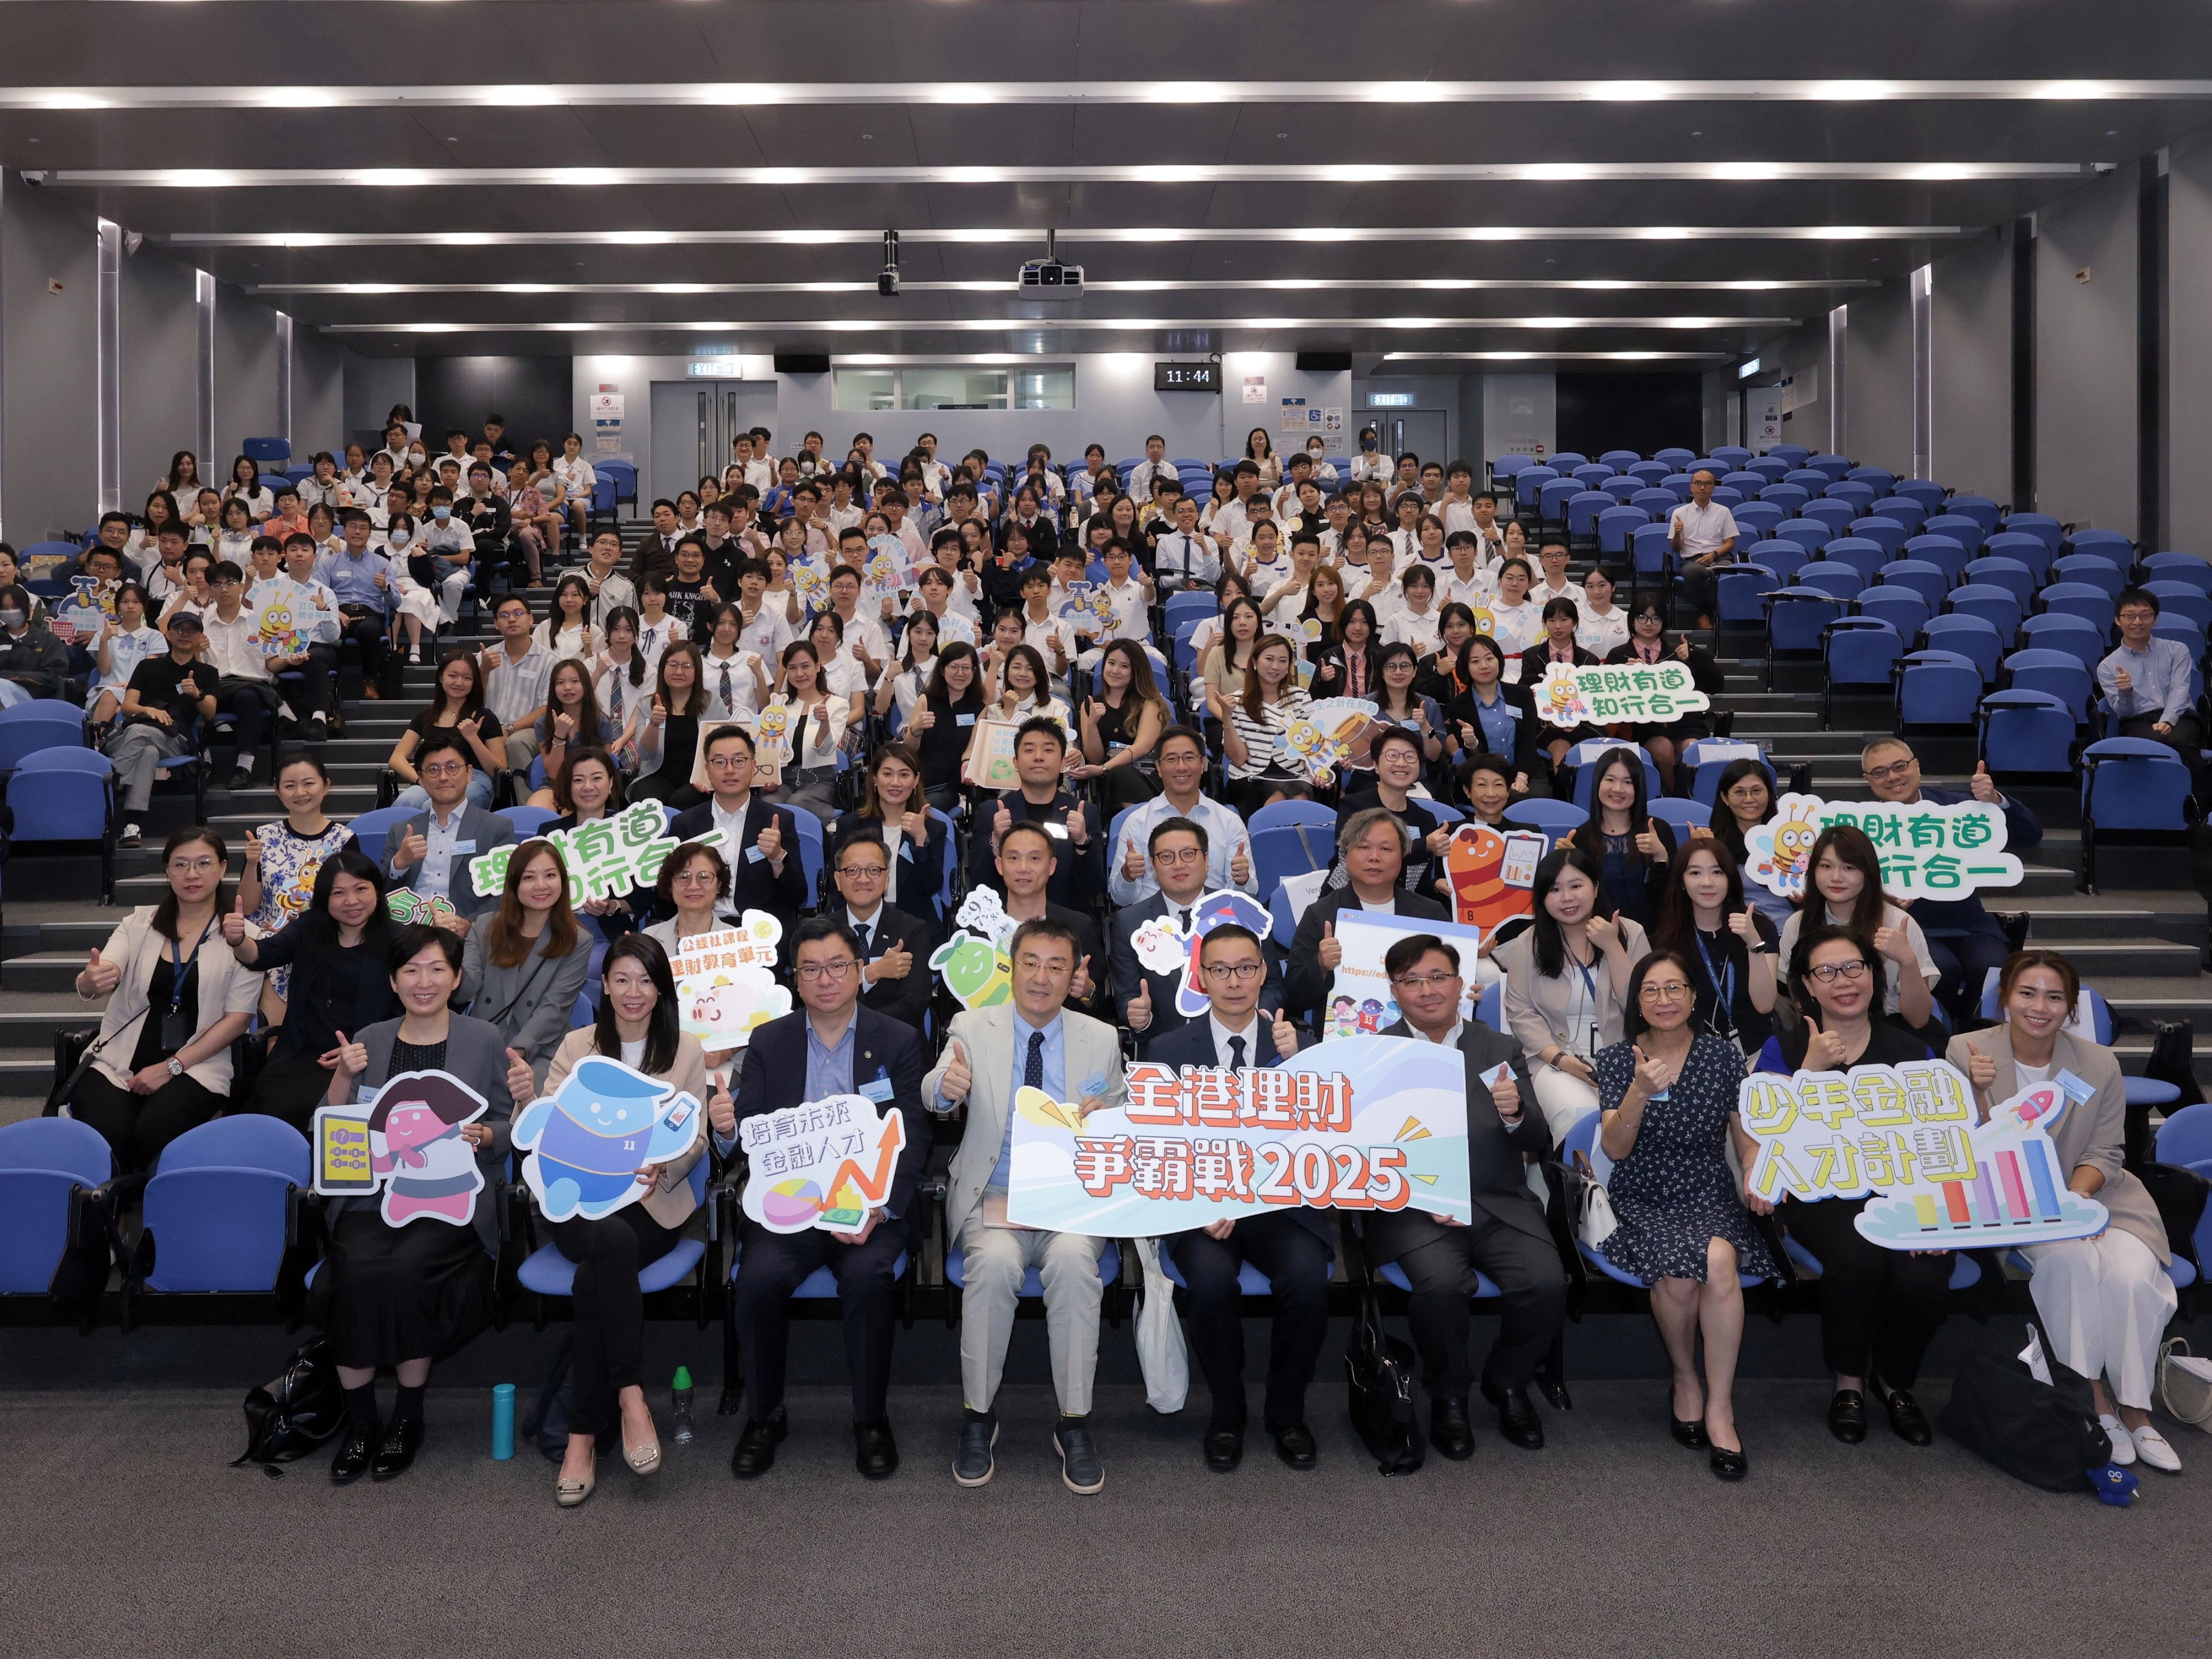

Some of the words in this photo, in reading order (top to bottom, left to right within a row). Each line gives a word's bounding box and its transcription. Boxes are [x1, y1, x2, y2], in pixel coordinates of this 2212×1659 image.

[693, 363, 714, 375] EXIT
[716, 364, 733, 374] 出口
[1166, 370, 1211, 382] 11:44
[1373, 395, 1392, 405] EXIT
[1394, 395, 1409, 405] 出口
[1576, 668, 1686, 693] 理財有道
[1592, 693, 1700, 718] 知行合一
[1467, 910, 1474, 921] 8
[682, 929, 749, 953] 公經社課程
[669, 945, 773, 977] 理財教育單元
[1364, 1015, 1373, 1025] 33
[1124, 1061, 1352, 1133] 全港理財
[1746, 1067, 1968, 1136] 少年金融
[340, 1131, 346, 1142] ?
[746, 1100, 851, 1148] 培育未來
[623, 1140, 635, 1151] 11
[761, 1127, 864, 1177] 金融人才
[1074, 1134, 1411, 1211] 爭霸戰2025
[1756, 1125, 1978, 1196] 人才計劃
